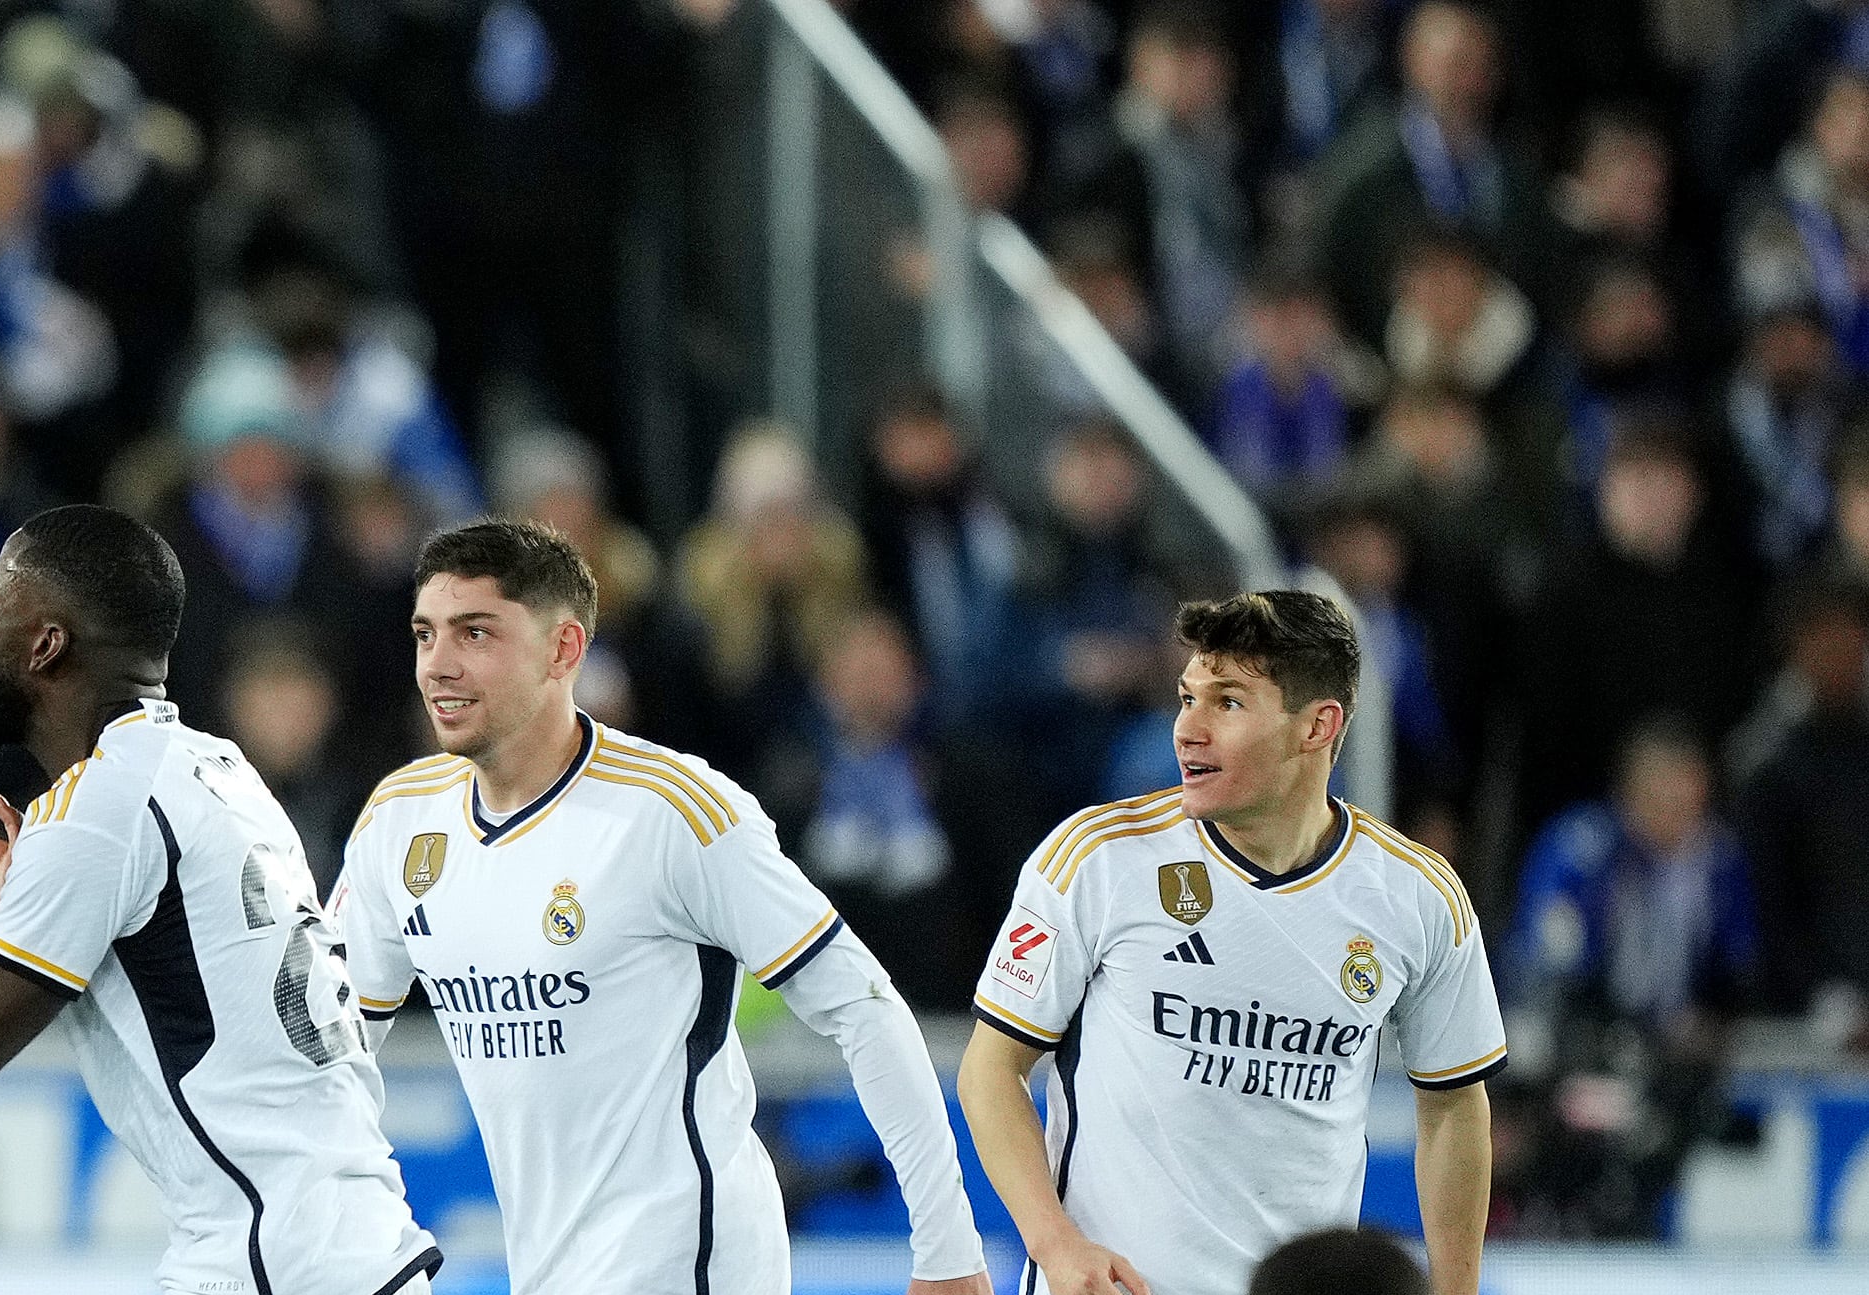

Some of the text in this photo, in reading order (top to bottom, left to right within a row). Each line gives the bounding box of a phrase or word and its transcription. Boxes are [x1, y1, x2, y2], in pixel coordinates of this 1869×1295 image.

[1176, 901, 1202, 911] FIFA
[996, 957, 1034, 985] LALIGA
[449, 1019, 567, 1059] FLY BETTER
[1184, 1049, 1337, 1101] FLY BETTER
